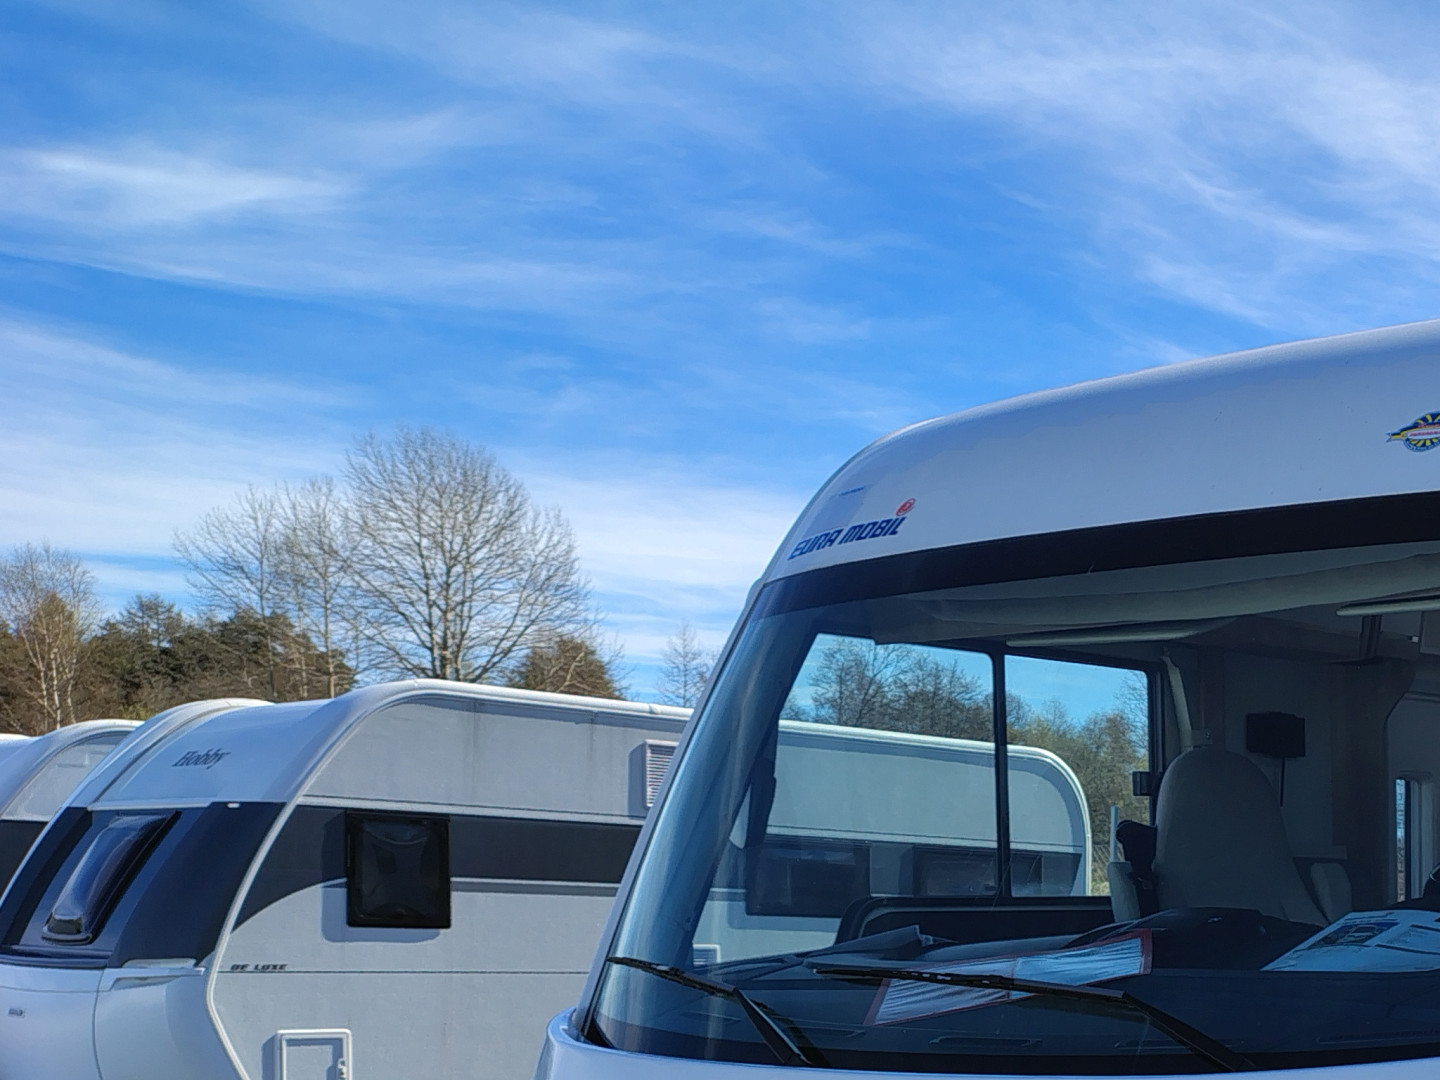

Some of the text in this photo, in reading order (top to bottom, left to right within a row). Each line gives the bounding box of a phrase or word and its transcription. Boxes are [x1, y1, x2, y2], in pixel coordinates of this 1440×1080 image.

[788, 516, 907, 560] EURA MOBIL
[171, 747, 232, 770] Hobby
